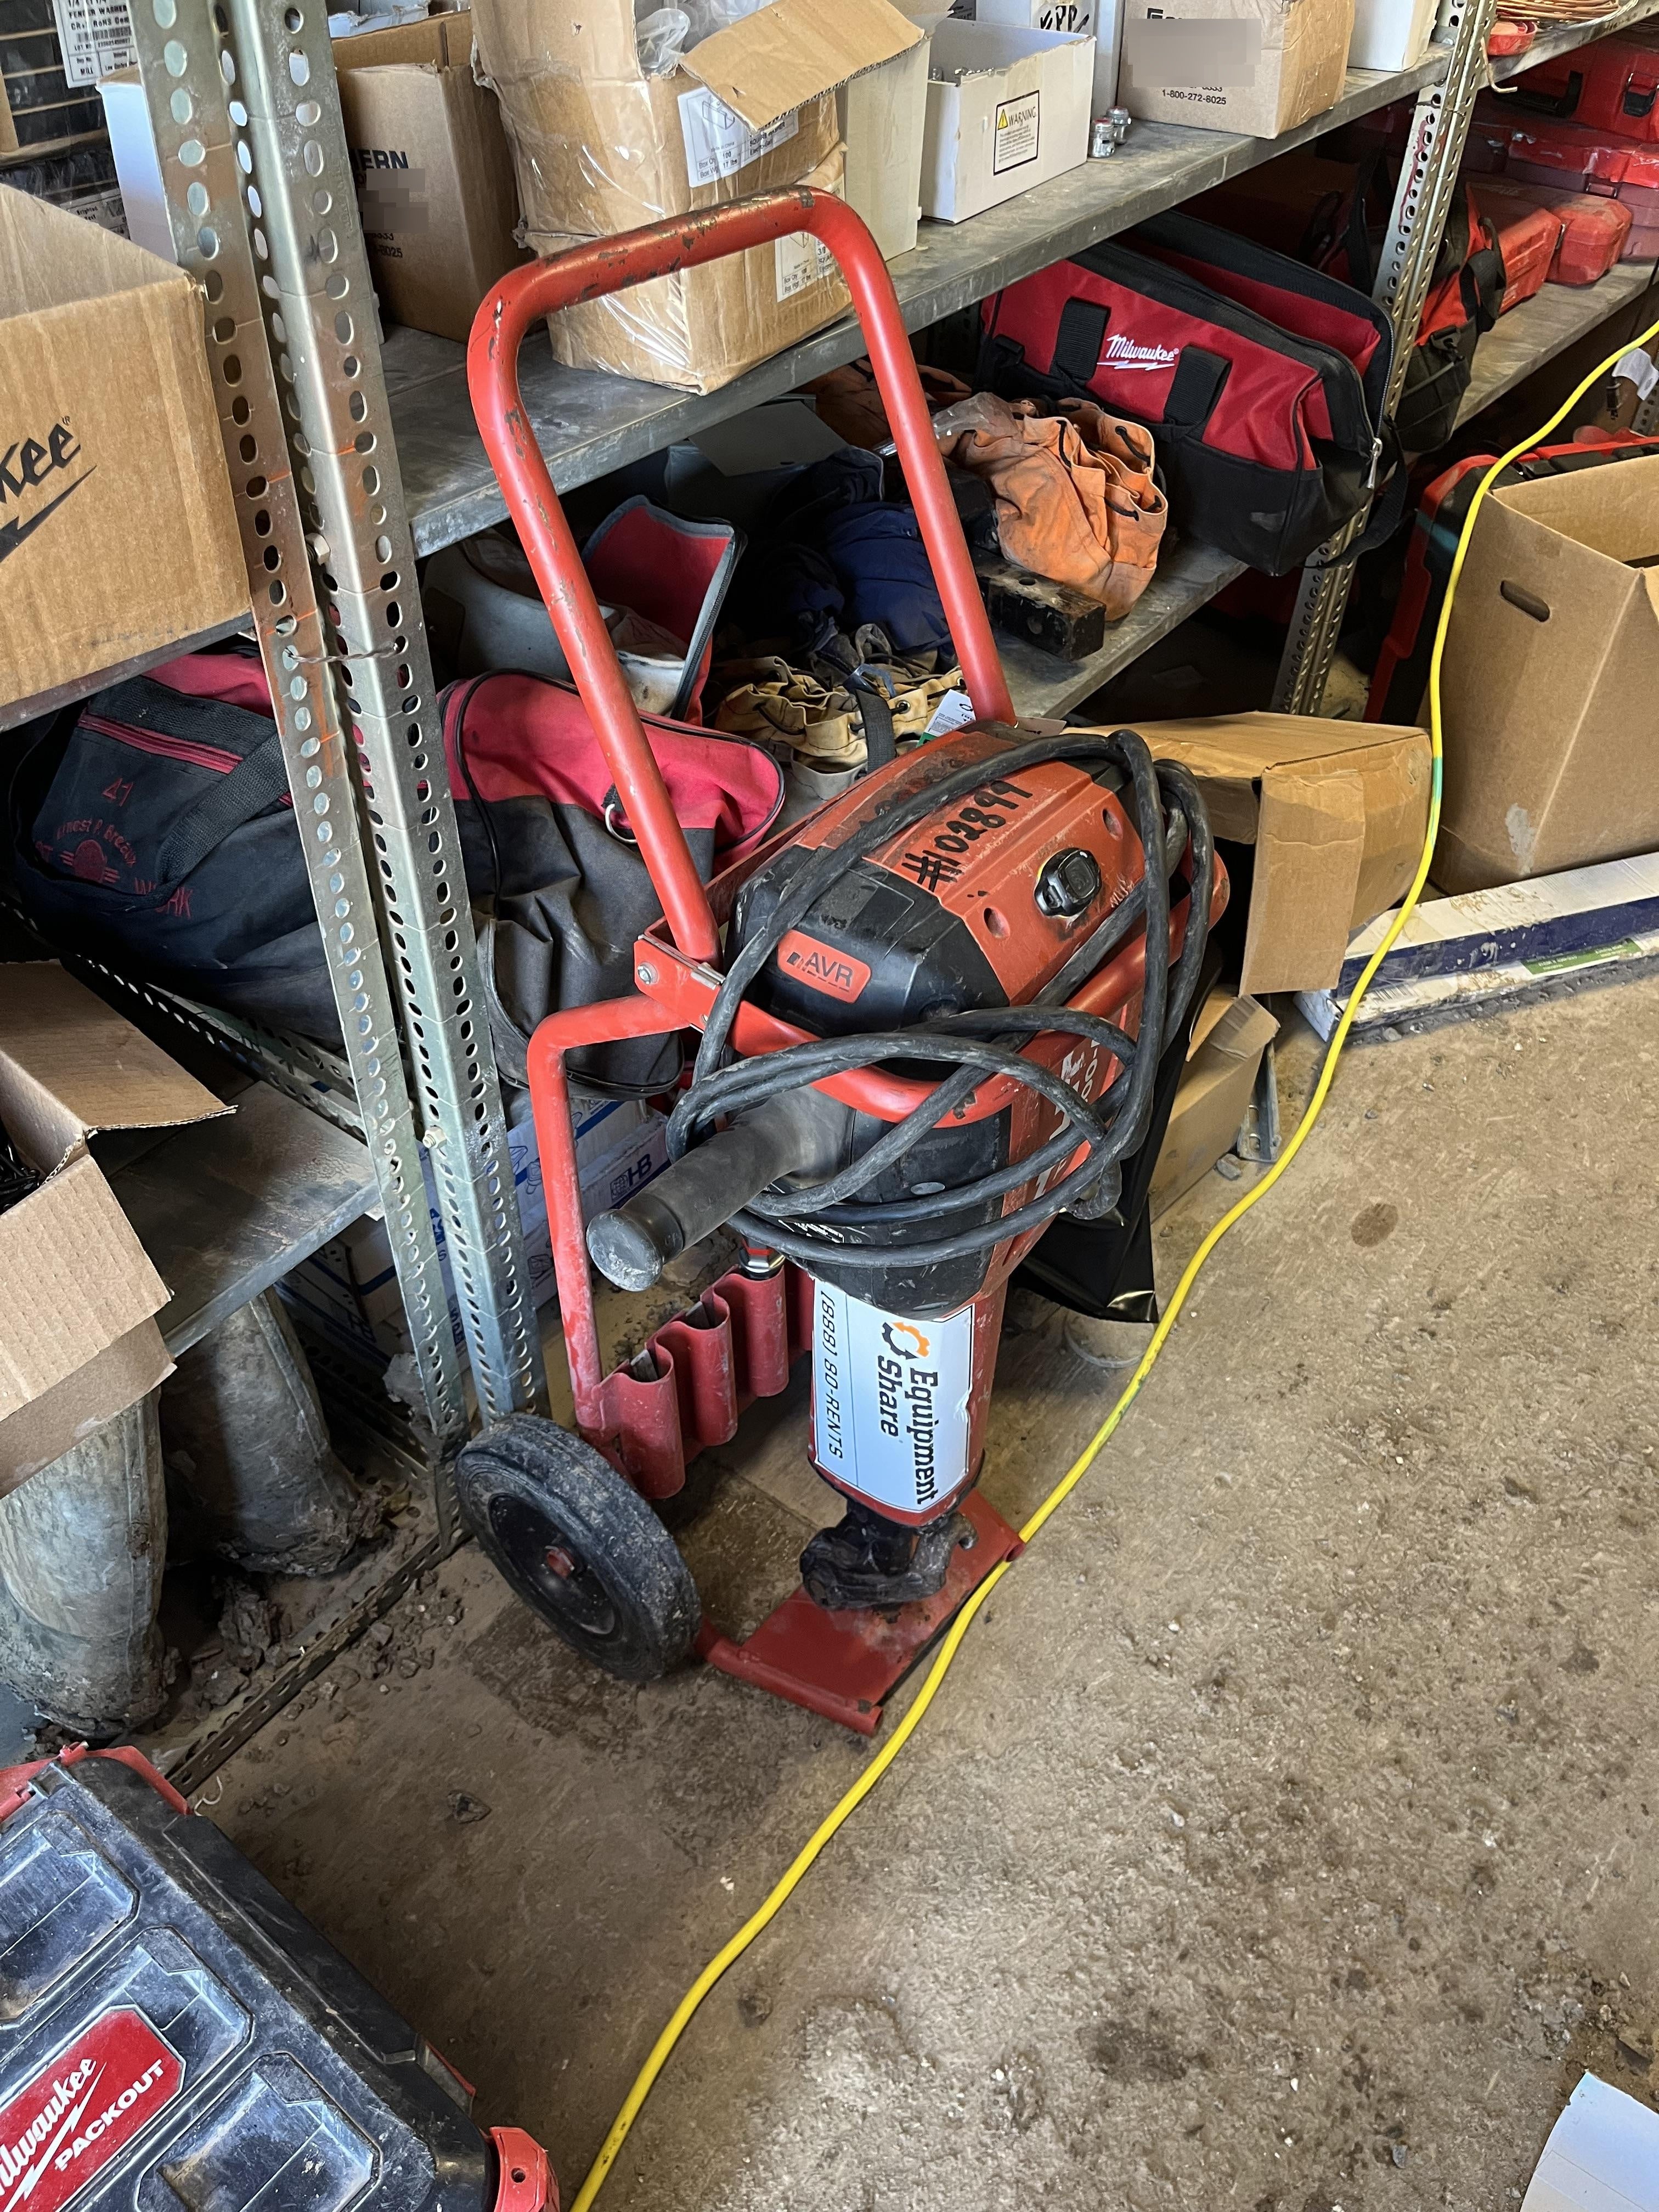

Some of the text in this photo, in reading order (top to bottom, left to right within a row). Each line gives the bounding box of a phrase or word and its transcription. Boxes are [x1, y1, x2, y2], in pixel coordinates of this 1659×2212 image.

[1163, 89, 1227, 105] 1-800-272-8025
[1009, 106, 1037, 126] WARNING
[699, 161, 708, 169] Box
[700, 170, 710, 178] Box
[1106, 334, 1175, 361] Milwaukee
[901, 780, 1033, 893] #102899
[804, 952, 854, 987] AVR
[628, 1153, 652, 1187] HB
[821, 1290, 843, 1459] (888) 80-RENTS
[878, 1355, 903, 1437] Share
[905, 1367, 940, 1505] Equipment
[55, 2059, 164, 2172] PACKOUT
